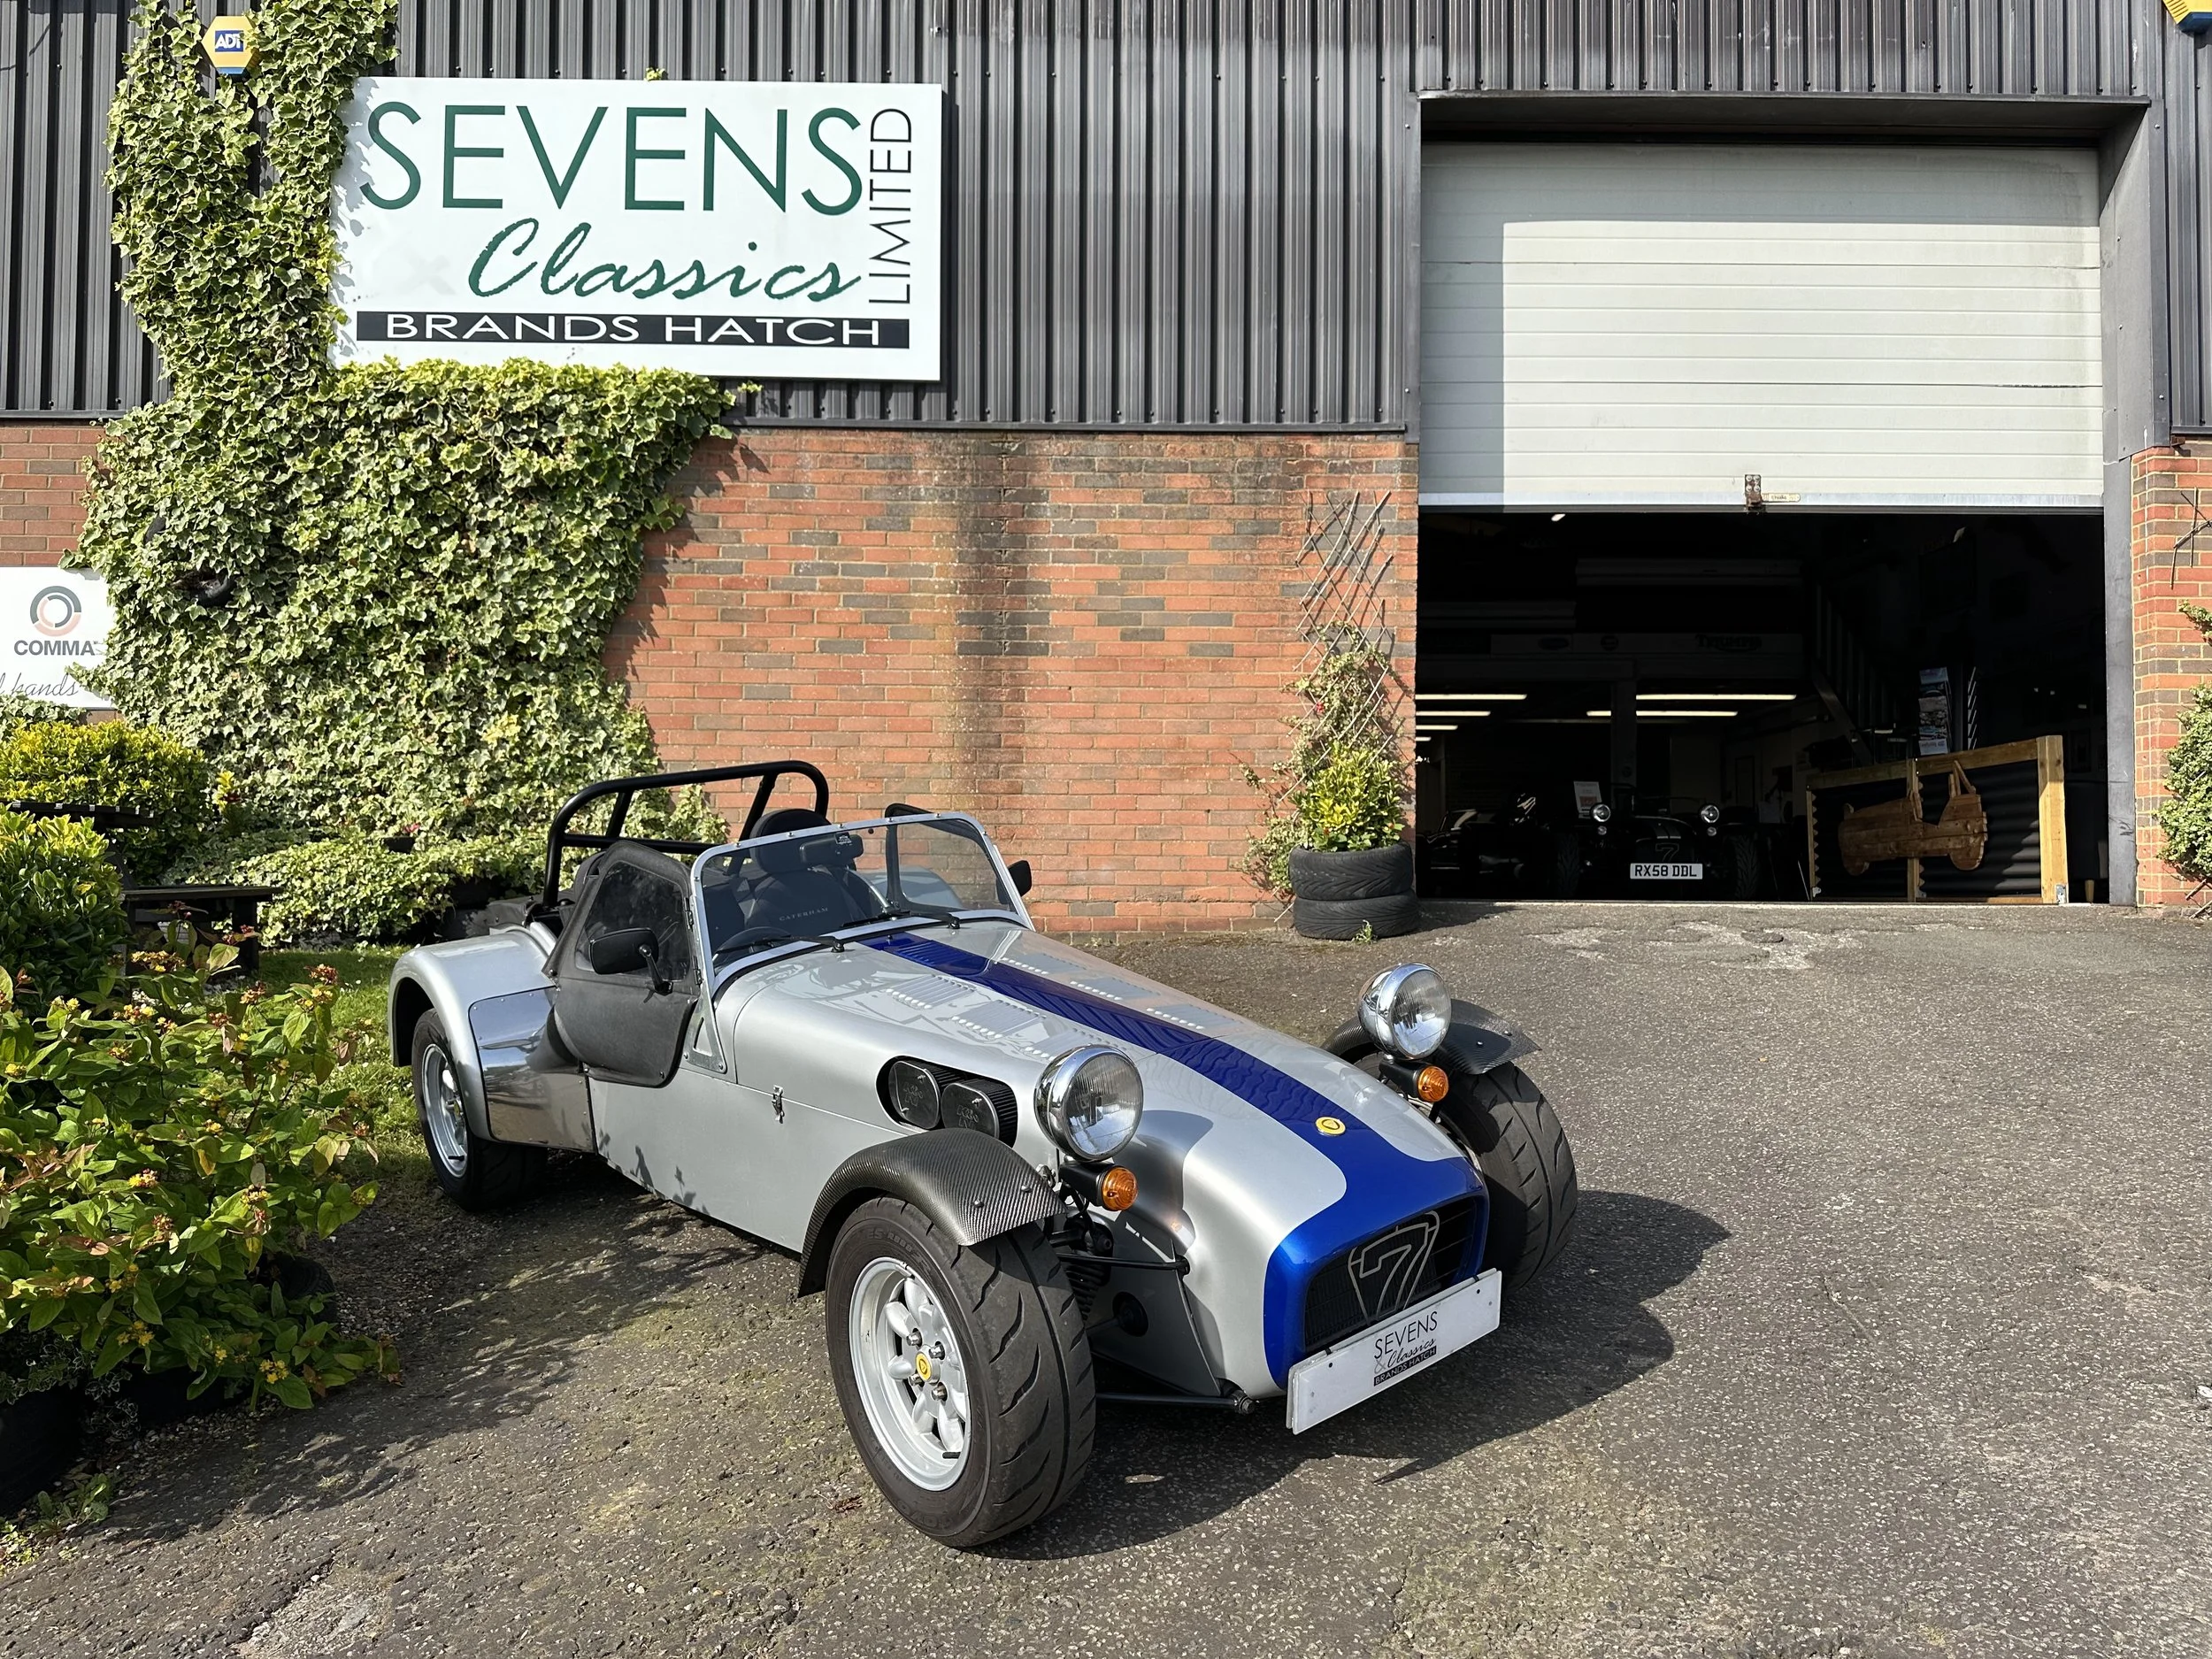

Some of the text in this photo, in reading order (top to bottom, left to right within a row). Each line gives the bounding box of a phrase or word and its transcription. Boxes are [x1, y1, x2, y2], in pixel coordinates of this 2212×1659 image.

[215, 34, 241, 49] ADT
[360, 101, 863, 216] SEVENS
[868, 107, 912, 305] LIMITED
[468, 218, 862, 303] Classics
[386, 313, 880, 346] BRANDS HATCH
[14, 640, 95, 656] COMMA
[12, 672, 78, 695] hands
[1635, 864, 1697, 877] RX58 DDL
[779, 907, 828, 921] CATERHAM
[1374, 1311, 1438, 1359] SEVENS
[1375, 1348, 1437, 1385] BRANDS HATCH
[1387, 1338, 1436, 1368] Classics
